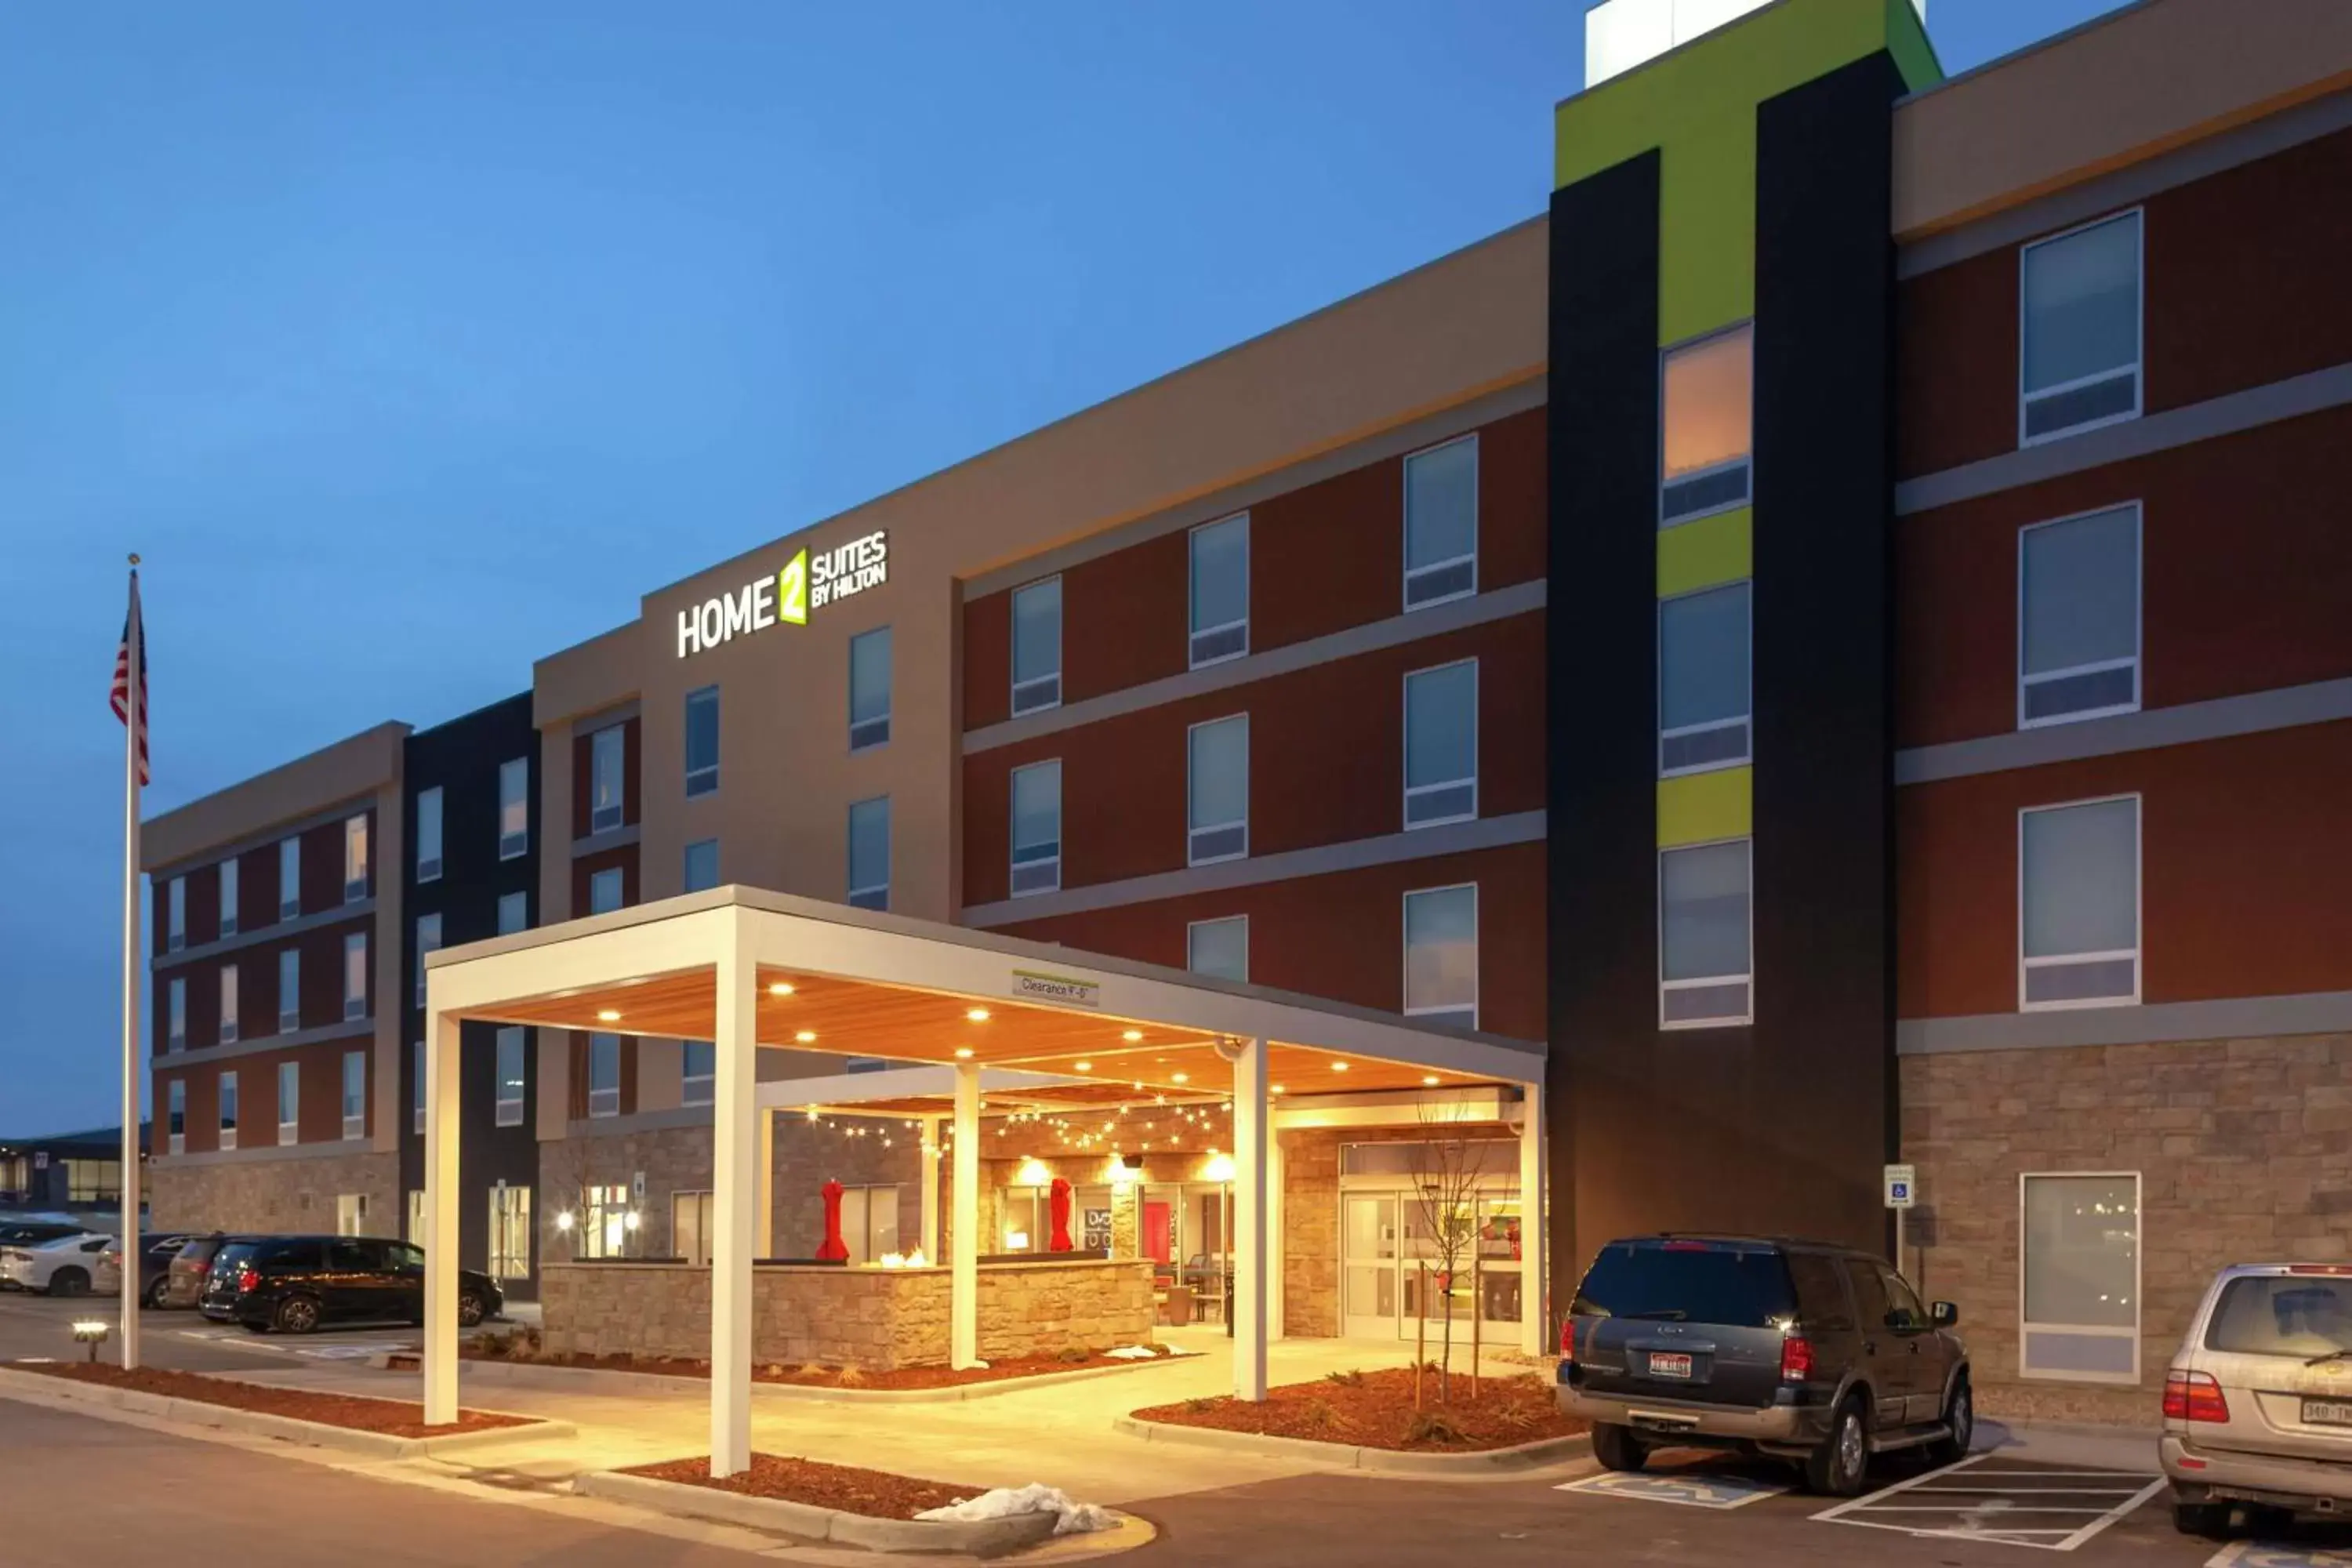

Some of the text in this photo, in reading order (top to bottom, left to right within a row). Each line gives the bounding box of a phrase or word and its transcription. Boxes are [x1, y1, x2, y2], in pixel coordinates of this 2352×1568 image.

[811, 530, 887, 586] SUITES
[811, 561, 887, 608] BY HILTON
[677, 574, 776, 659] HOME
